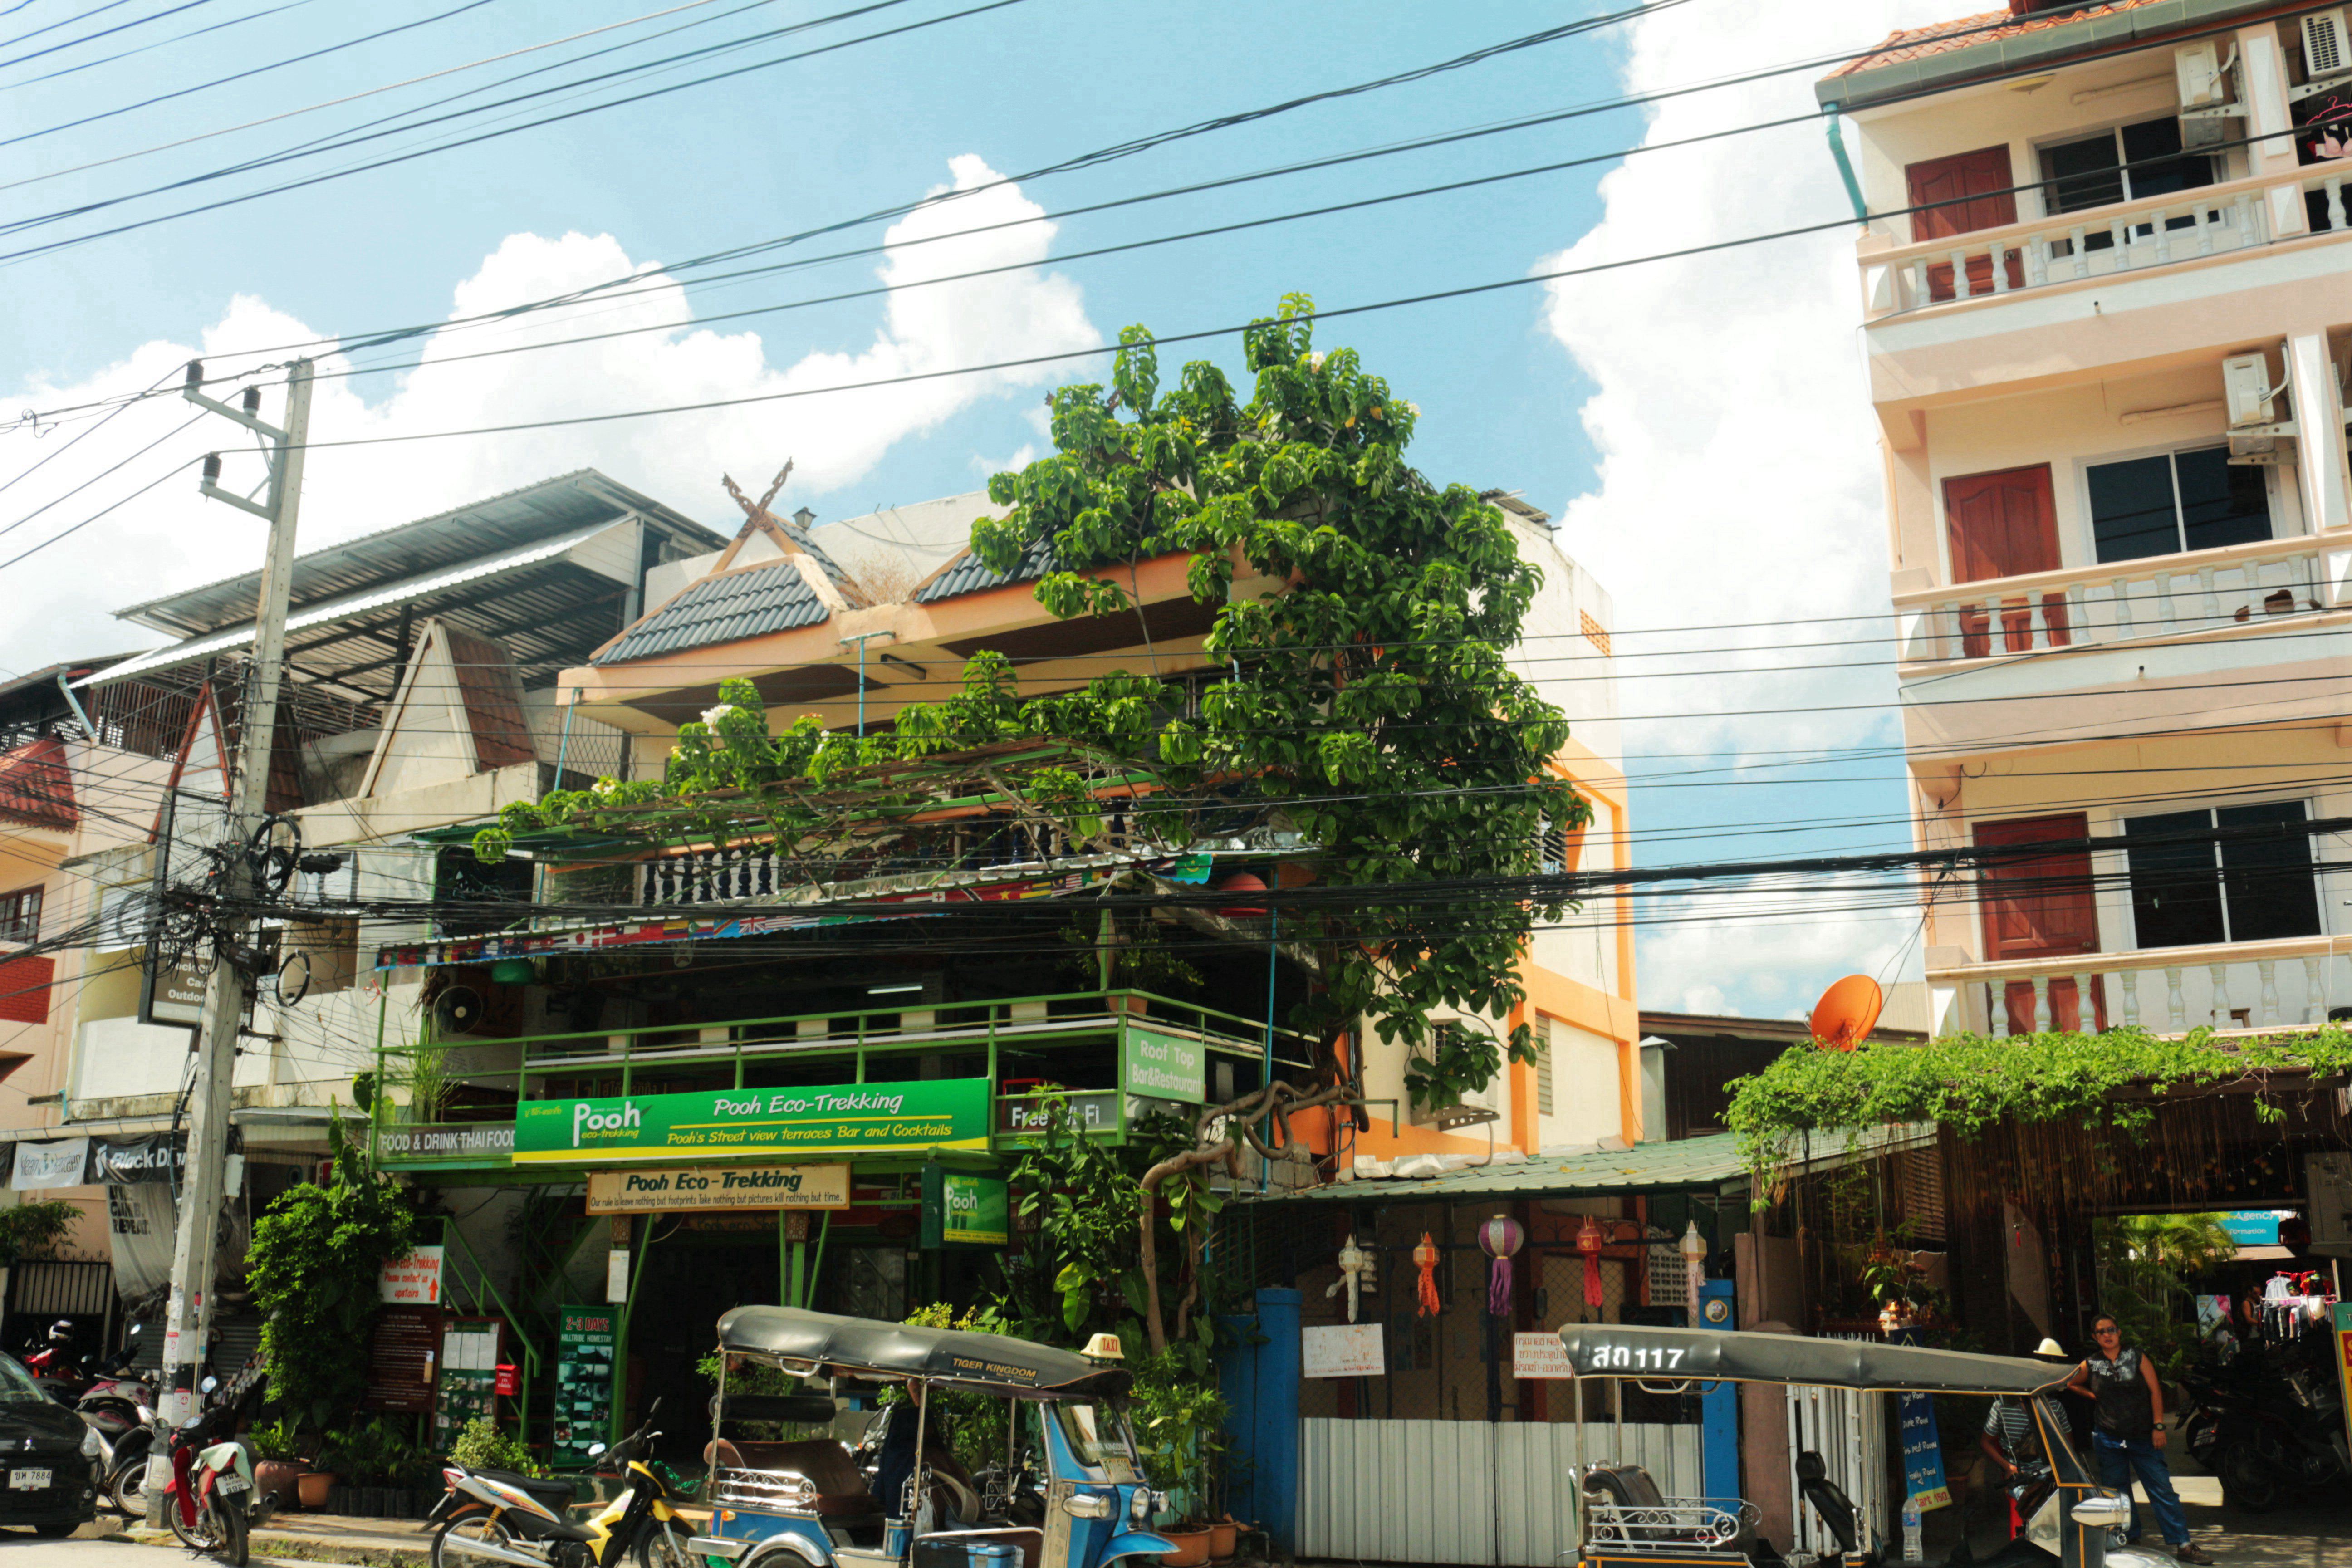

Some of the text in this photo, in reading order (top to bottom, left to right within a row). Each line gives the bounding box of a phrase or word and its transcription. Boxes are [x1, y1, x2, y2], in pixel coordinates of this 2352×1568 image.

[168, 959, 196, 972] ock
[1141, 1040, 1195, 1070] Roof Top
[1132, 1063, 1201, 1094] Bar&Restaurant
[714, 1093, 903, 1116] Pooh Eco-Trekking
[573, 1101, 640, 1147] Pooh
[1012, 1107, 1048, 1127] Free
[381, 1135, 410, 1150] FOOD
[413, 1134, 421, 1150] &
[424, 1133, 457, 1149] DRINK
[460, 1132, 485, 1147] THAI
[581, 1129, 640, 1139] eco-trekking
[667, 1123, 952, 1144] Pooh's Street view terraces Bar and Cocktails
[110, 1148, 155, 1169] Black
[626, 1174, 669, 1191] Pooh
[591, 1191, 843, 1207] Our rule is leave nothing but footprints Take nothing but pictures kill nothing but time.
[946, 1186, 977, 1221] Pooh
[402, 1272, 421, 1283] contact
[395, 1287, 419, 1300] upstairs
[566, 1316, 609, 1332] 2-3 DAYS
[561, 1334, 612, 1343] HILLTRIBE HOMESTAY
[1102, 1338, 1118, 1352] TAXI
[953, 1358, 984, 1370] TIGER
[986, 1363, 1037, 1378] KINGDOM
[31, 1471, 51, 1480] 7884
